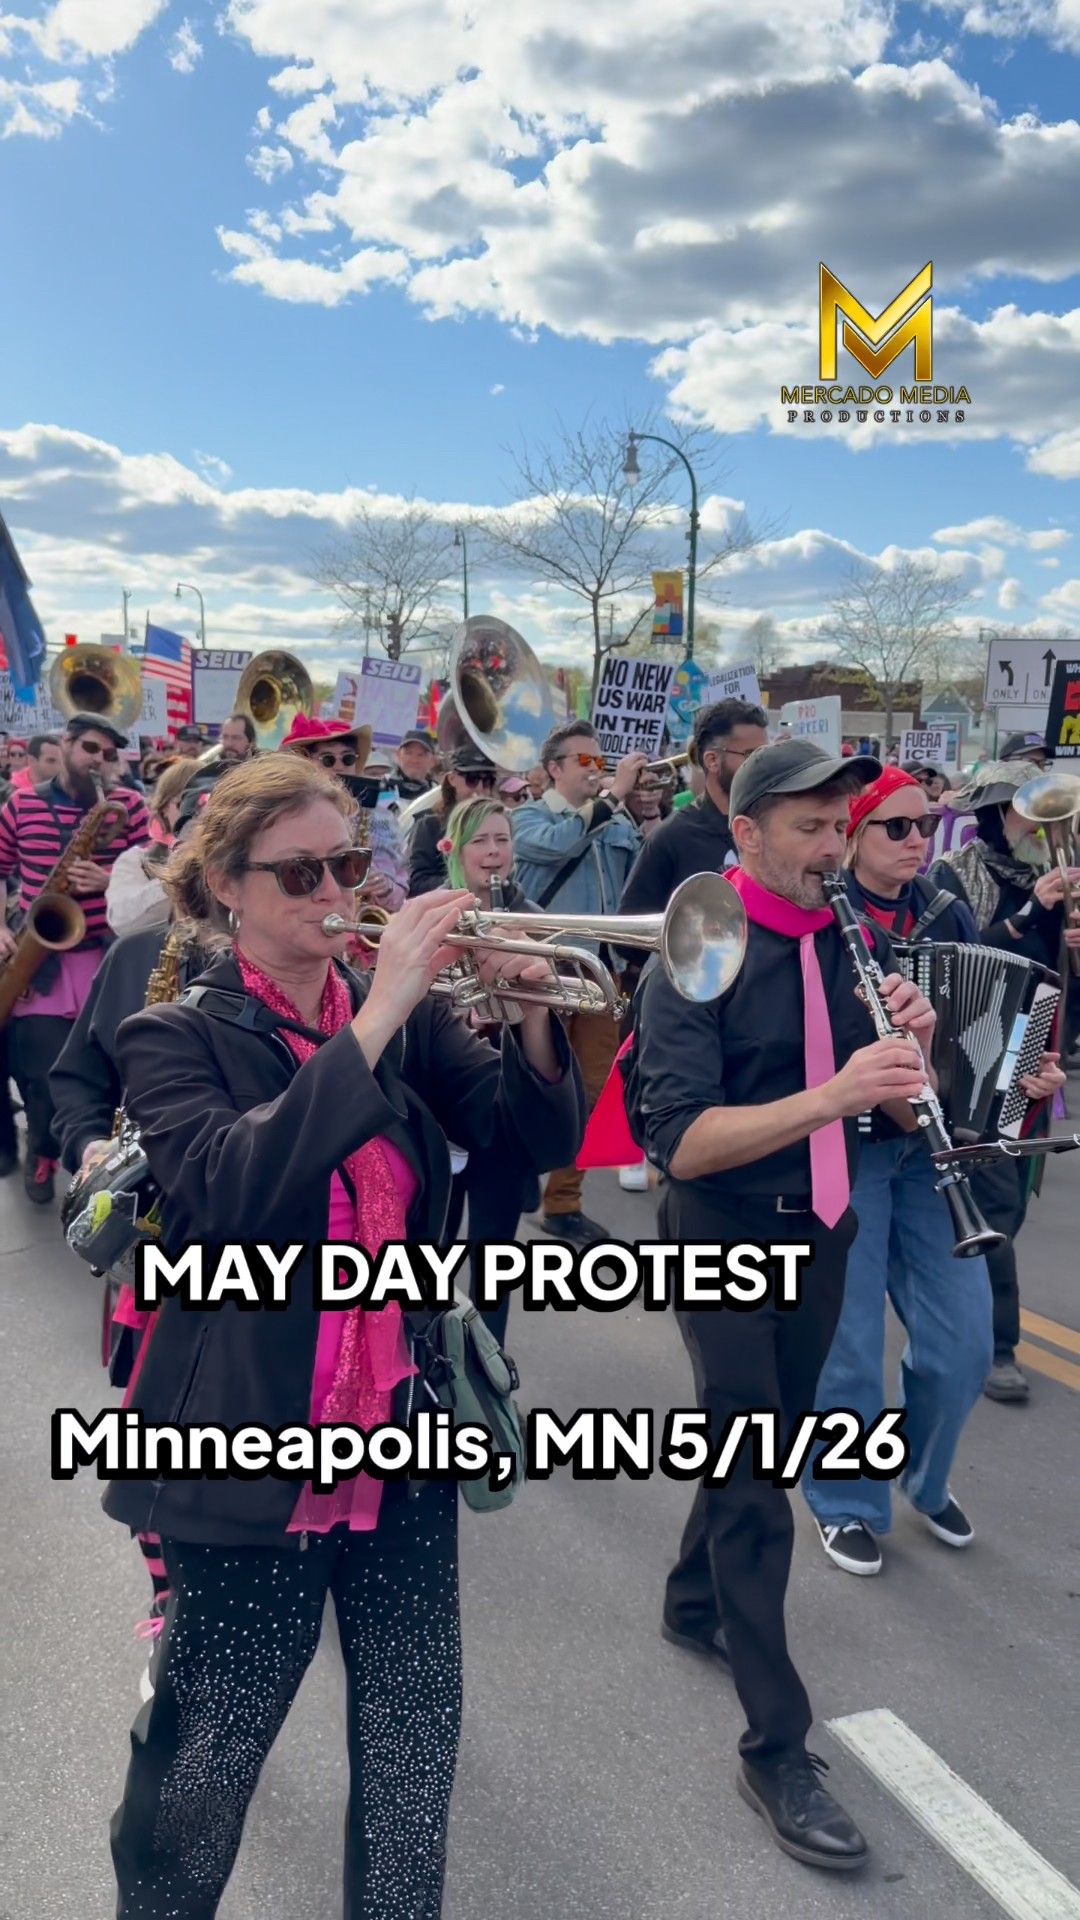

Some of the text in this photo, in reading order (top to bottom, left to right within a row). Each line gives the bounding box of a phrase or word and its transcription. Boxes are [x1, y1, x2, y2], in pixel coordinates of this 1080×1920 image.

[195, 650, 250, 669] SEIU
[366, 660, 418, 681] SEIU
[601, 658, 674, 693] NO NEW
[709, 664, 757, 688] LEGALIZATION
[724, 680, 742, 695] FOR
[992, 688, 1020, 700] ONLY
[597, 687, 667, 713] US WAR
[594, 713, 662, 735] IN THE
[905, 732, 942, 748] FUERA
[905, 749, 939, 761] ICE
